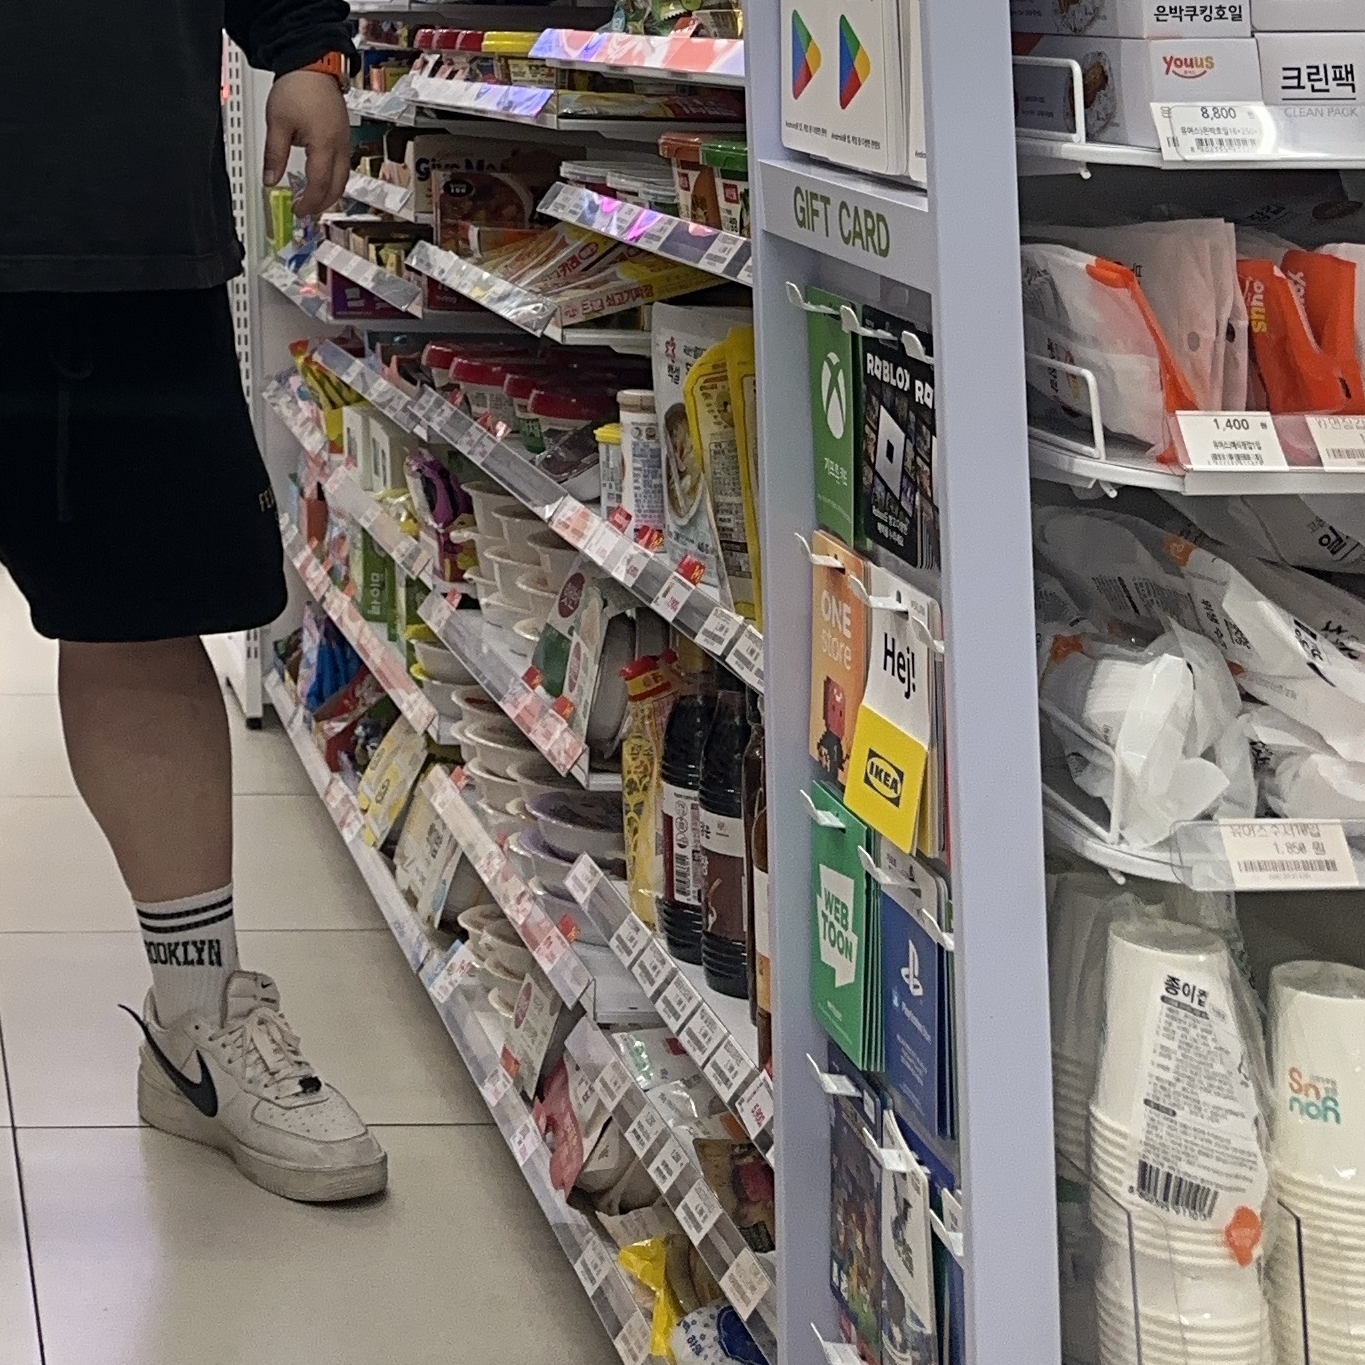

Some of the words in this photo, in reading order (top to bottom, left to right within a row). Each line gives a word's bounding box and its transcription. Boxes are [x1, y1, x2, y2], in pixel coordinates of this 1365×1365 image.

[1153, 4, 1244, 24] 은박쿠킹호일
[1163, 54, 1215, 76] youus
[1281, 64, 1357, 94] 크린팩
[1201, 107, 1236, 120] 8,800
[1284, 107, 1323, 118] CLEAN
[1326, 107, 1358, 118] PACK
[793, 185, 831, 230] GIFT
[839, 189, 890, 259] CARD
[1213, 418, 1250, 431] 1,400
[820, 588, 853, 639] ONE
[821, 629, 853, 671] store
[883, 632, 916, 700] Hej!
[868, 760, 900, 795] IKEA
[824, 886, 850, 933] WEB
[822, 909, 854, 964] TOON
